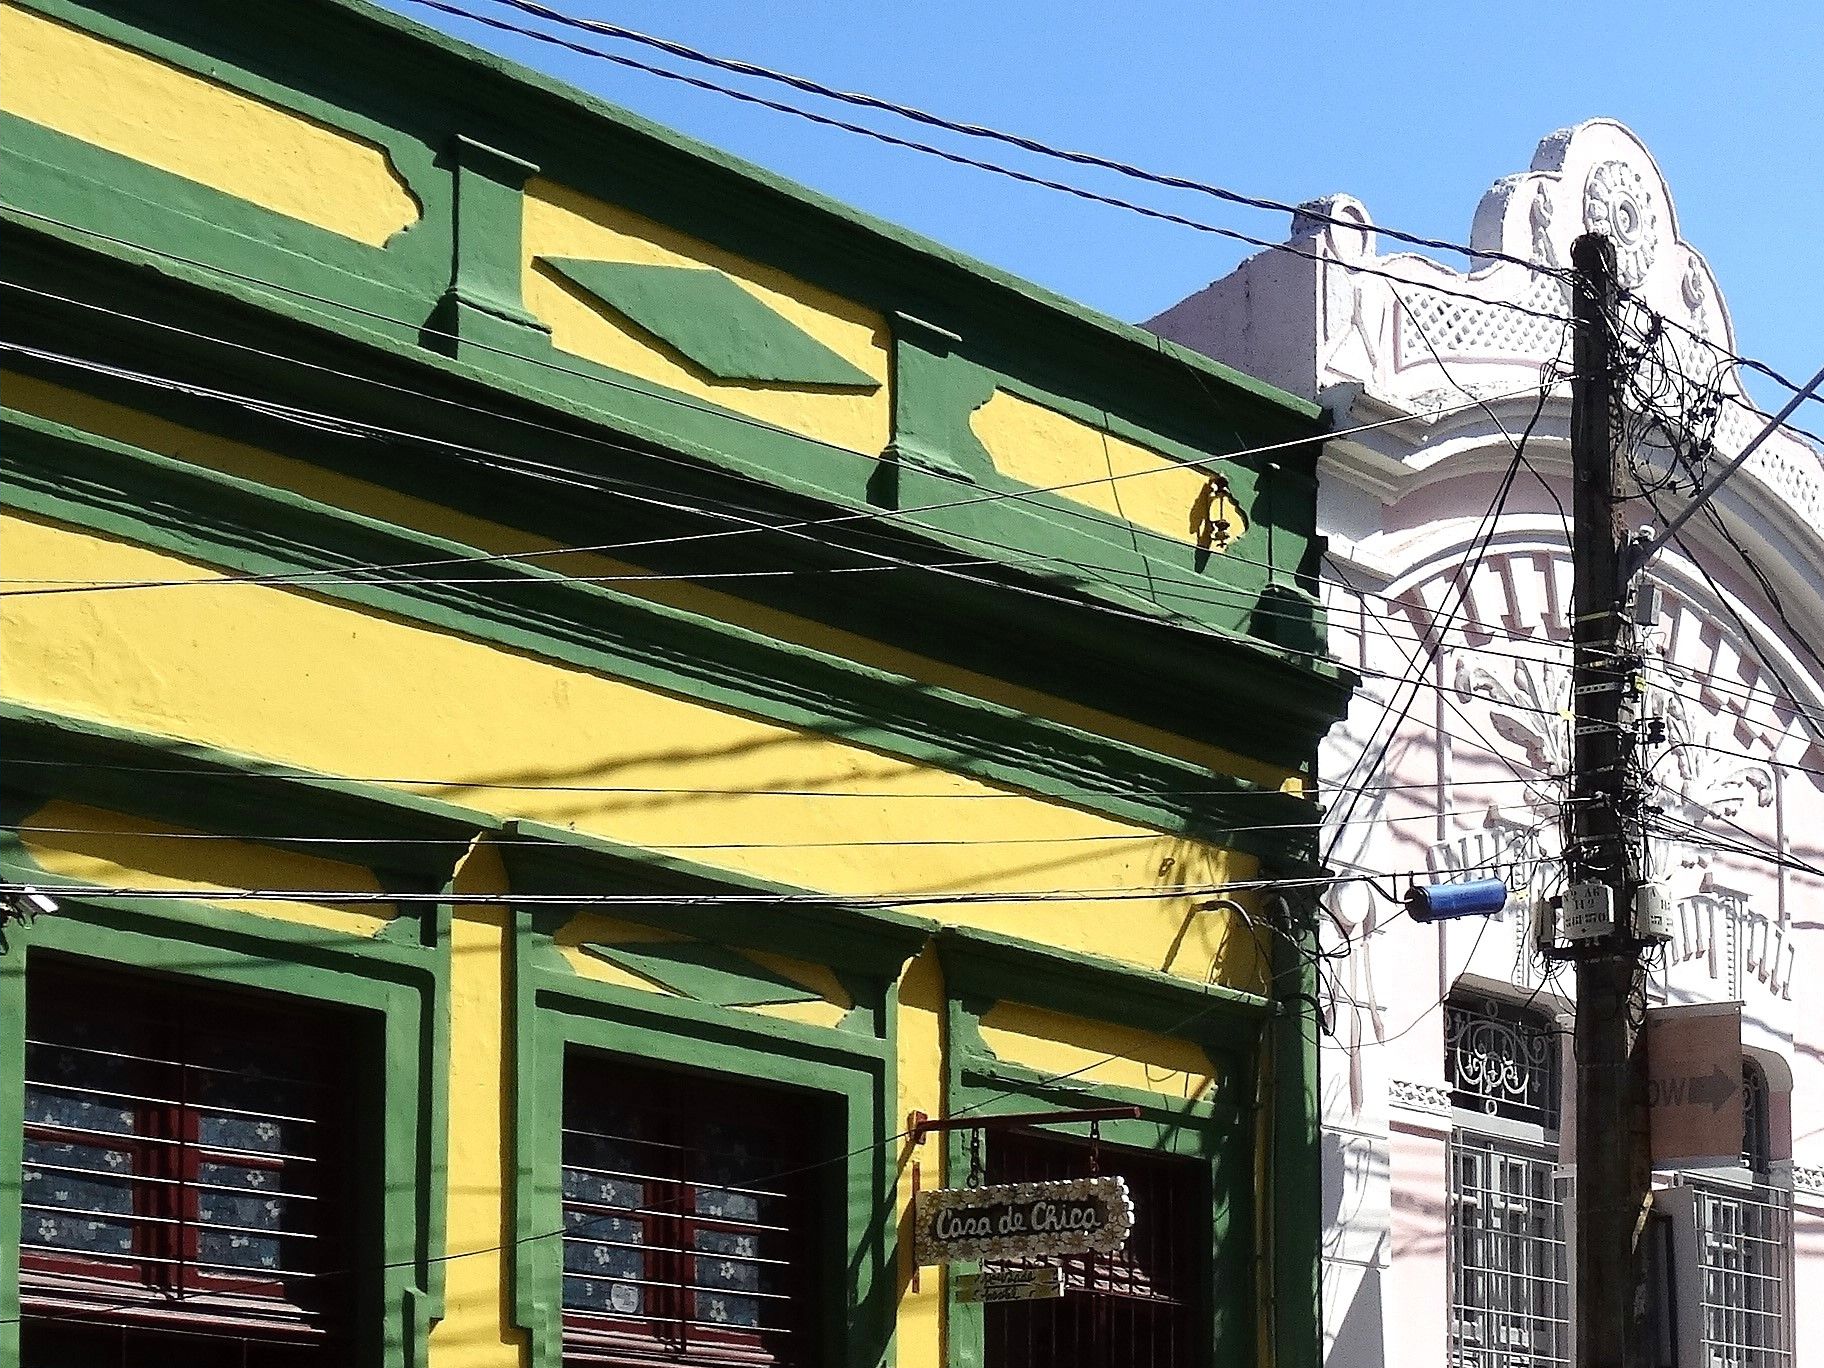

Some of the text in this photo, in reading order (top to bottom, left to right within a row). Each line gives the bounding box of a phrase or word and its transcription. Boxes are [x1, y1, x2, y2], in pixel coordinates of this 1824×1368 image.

[936, 1201, 1101, 1239] Casa de Chica
